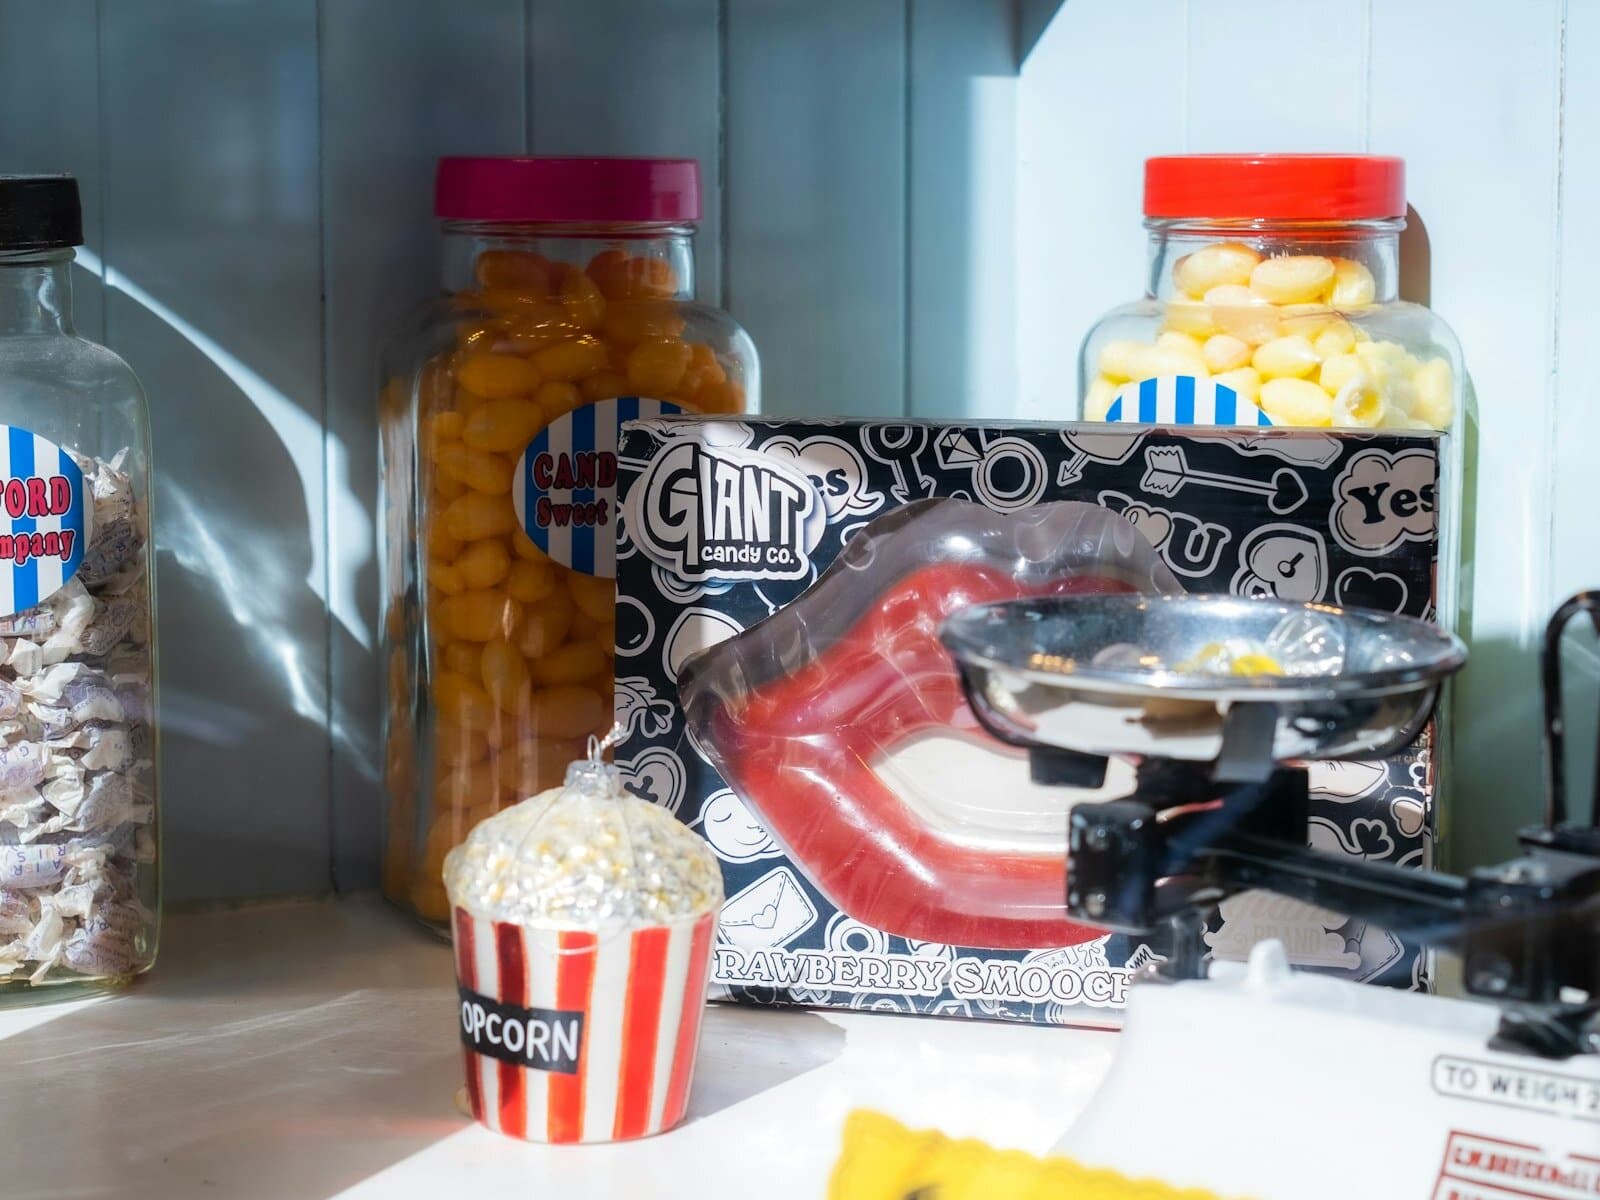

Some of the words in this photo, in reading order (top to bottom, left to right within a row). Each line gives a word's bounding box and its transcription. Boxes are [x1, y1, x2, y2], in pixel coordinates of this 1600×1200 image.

[0, 476, 71, 518] ORD
[536, 497, 609, 527] Sweet
[647, 443, 799, 566] GIANT
[701, 544, 761, 564] candy
[766, 547, 795, 564] co.
[713, 947, 946, 993] RAWBERRY
[461, 1000, 579, 1062] OPCORN
[1445, 1065, 1478, 1091] TO
